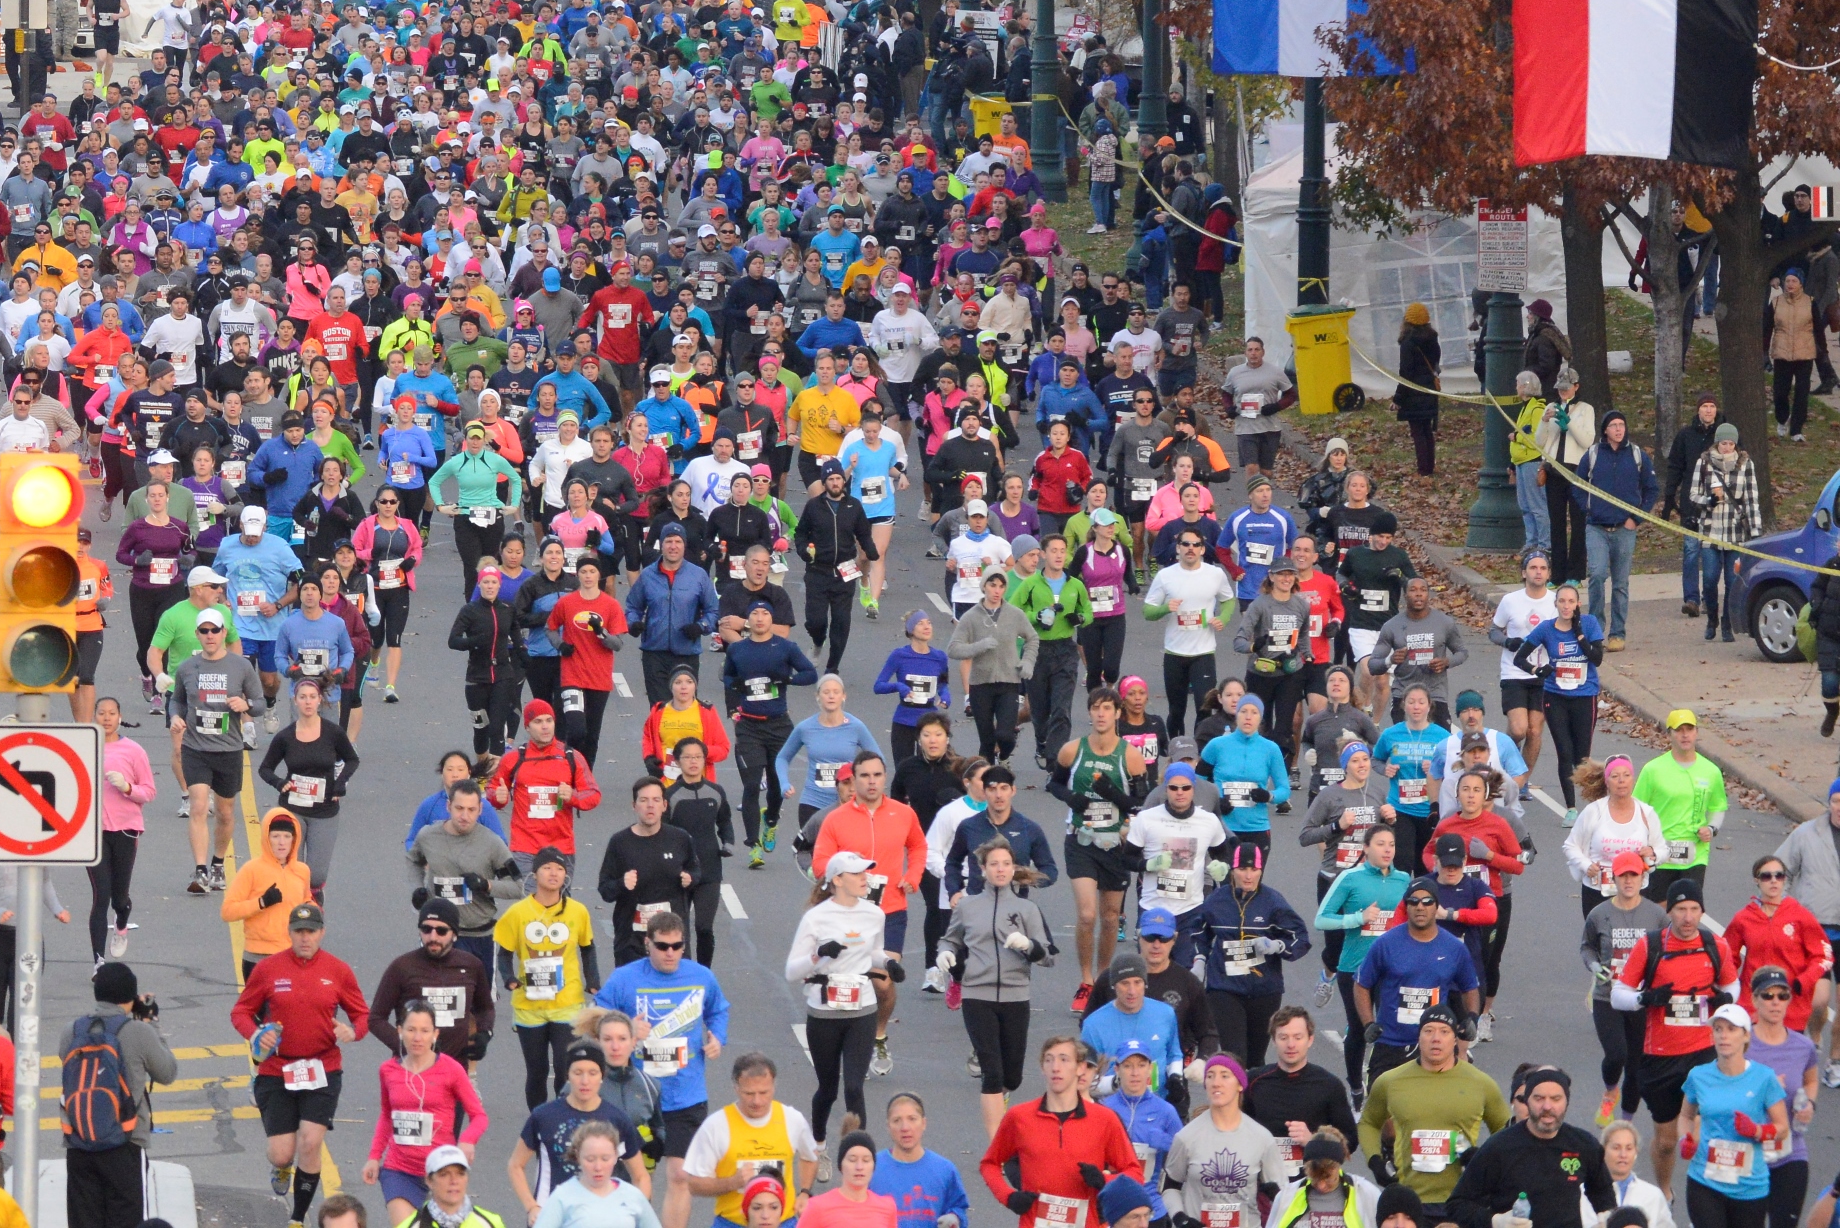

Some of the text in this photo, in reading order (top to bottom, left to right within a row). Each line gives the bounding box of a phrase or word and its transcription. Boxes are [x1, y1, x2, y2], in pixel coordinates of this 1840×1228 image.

[322, 328, 351, 338] BOSTON
[269, 354, 298, 373] NIKE
[1406, 633, 1434, 642] REDEFINE
[1406, 641, 1434, 650] POSSIBLE
[199, 674, 227, 683] REDEFINE
[199, 682, 227, 690] POSSIBLE
[1355, 814, 1376, 824] SSIBLE
[1601, 838, 1642, 847] Jersey Girls
[1612, 928, 1647, 938] REDEFINE
[428, 996, 453, 1004] CARLOS
[647, 1047, 676, 1055] TIMOTHY
[1419, 1138, 1443, 1147] SIMON
[1202, 1174, 1247, 1188] Goshen
[1211, 1186, 1238, 1195] College
[1059, 1198, 1077, 1206] 2012
[1048, 1205, 1068, 1215] SETH
[1208, 1212, 1233, 1220] INDIGO
